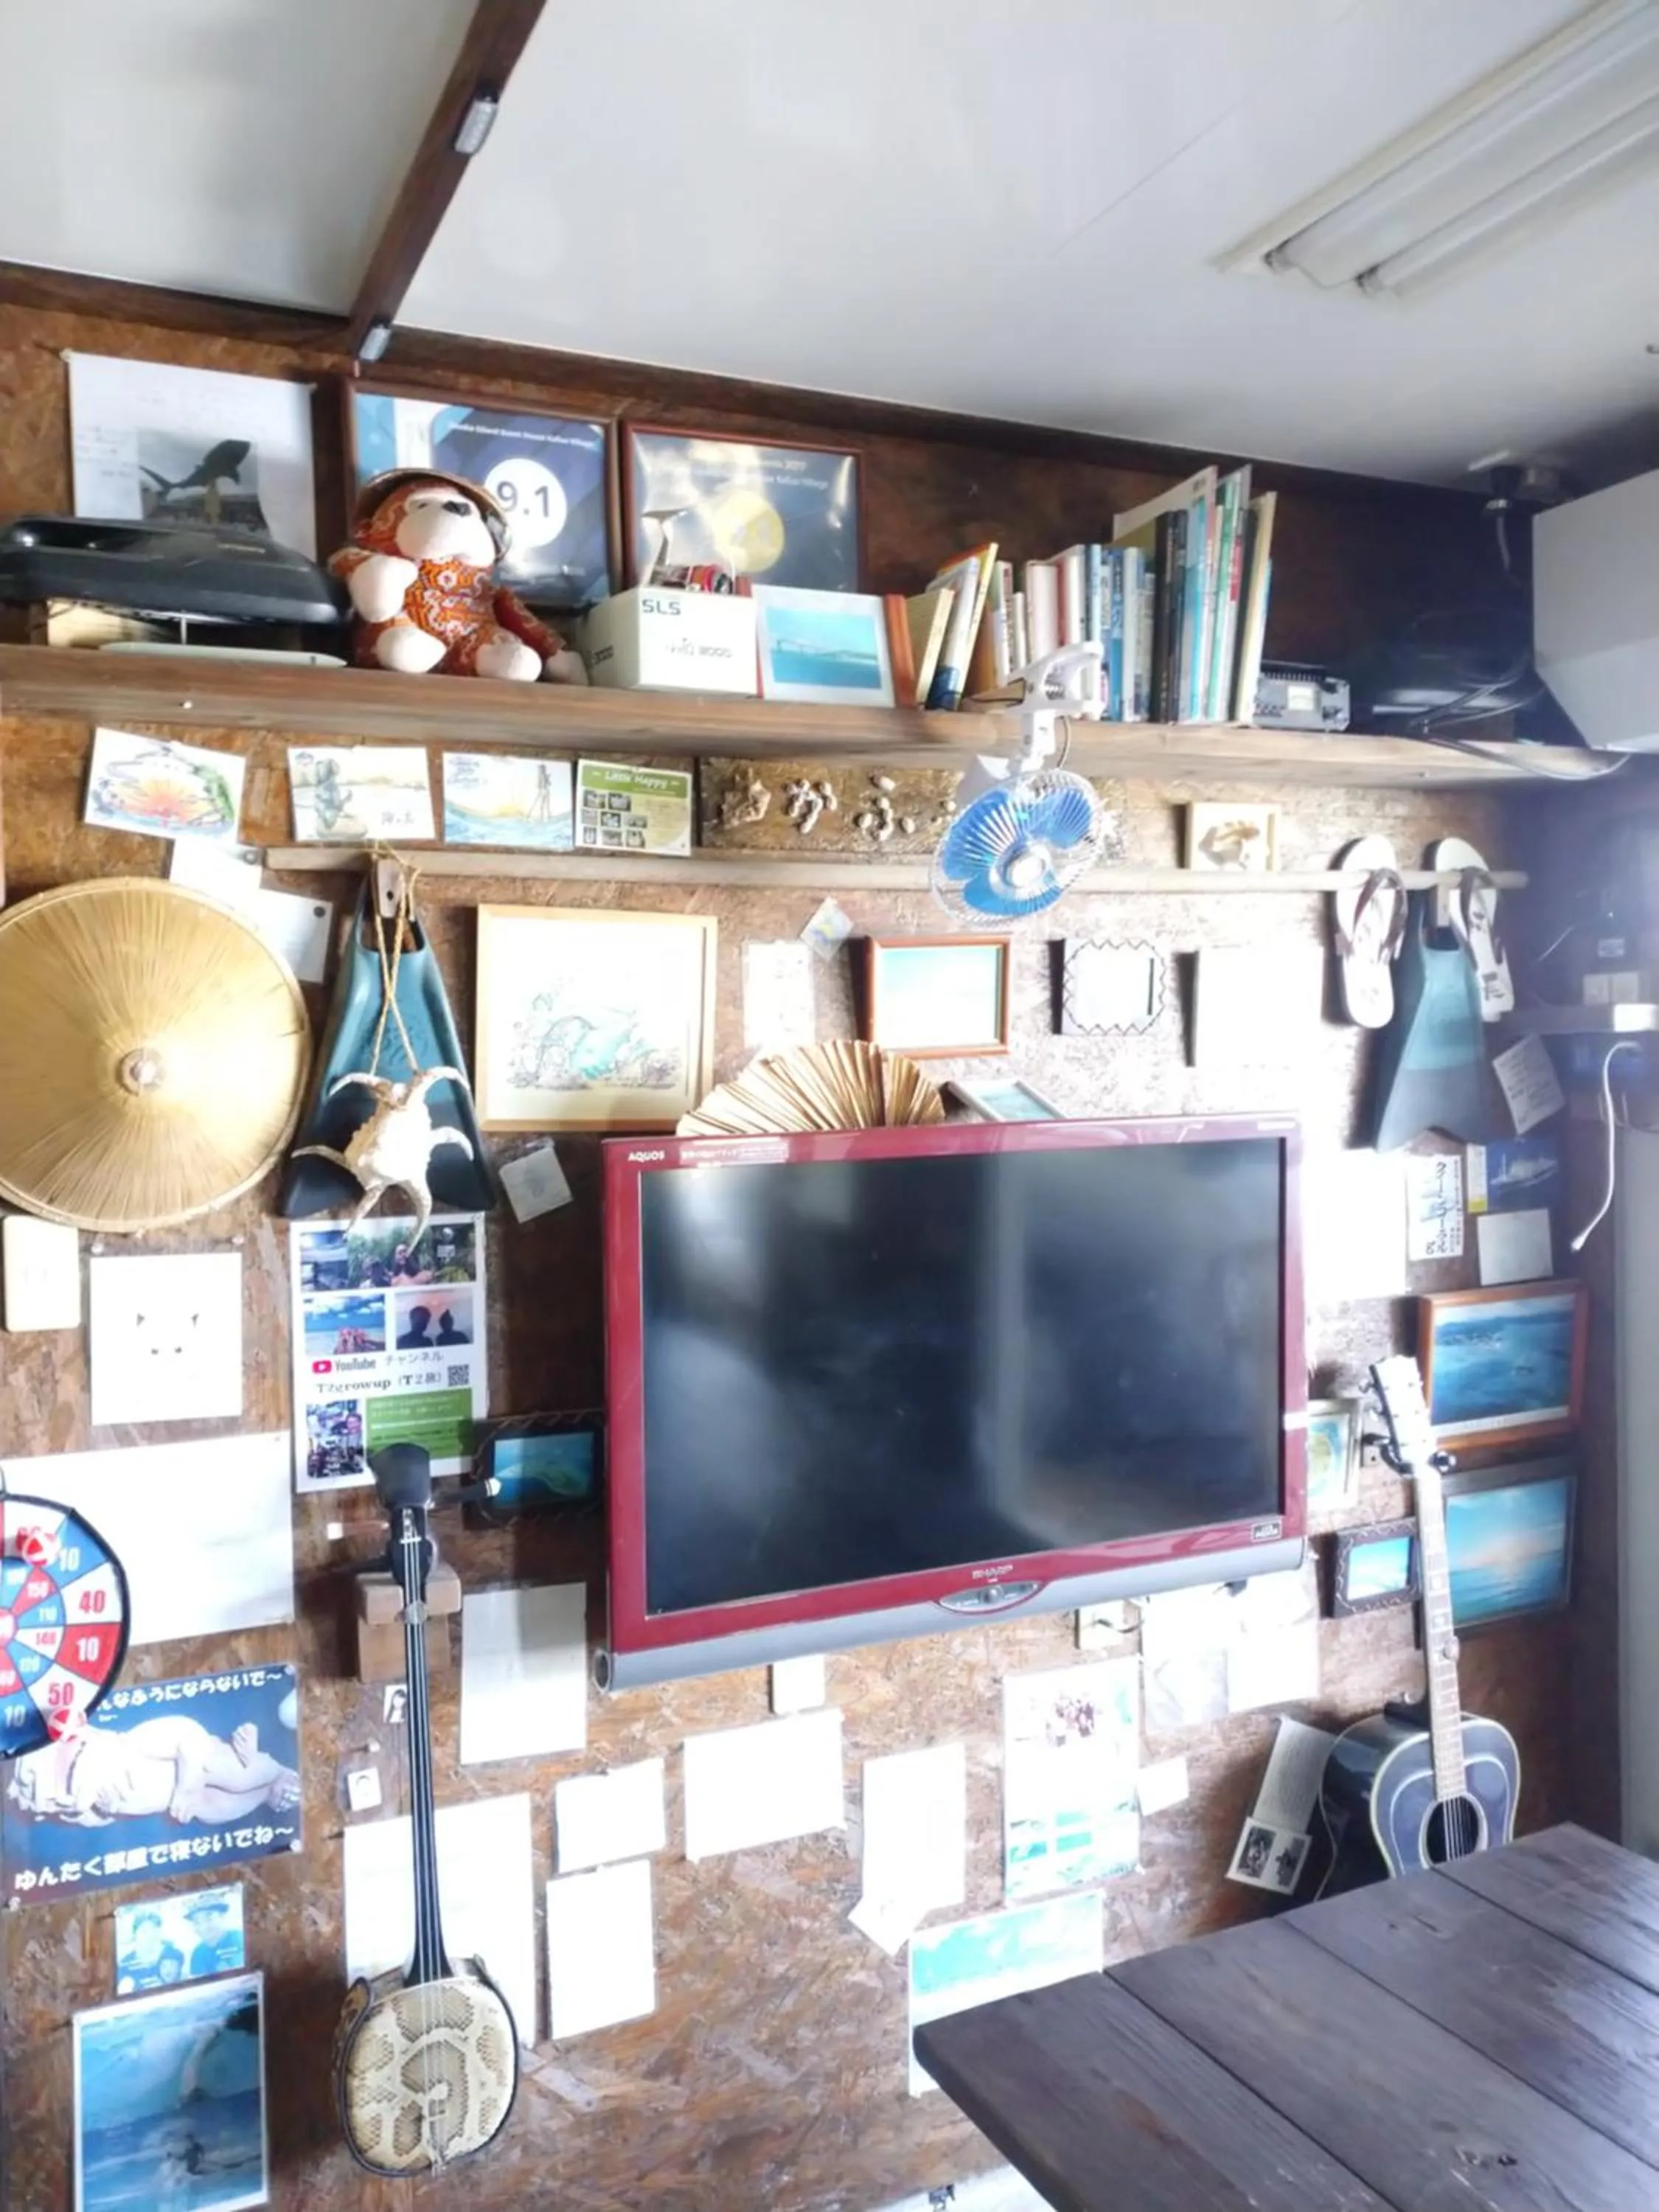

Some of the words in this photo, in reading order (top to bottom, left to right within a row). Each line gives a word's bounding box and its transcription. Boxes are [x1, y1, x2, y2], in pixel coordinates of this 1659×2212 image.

[497, 481, 549, 518] 9.1
[641, 599, 681, 615] SLS
[628, 1150, 665, 1163] AQUOS
[335, 1357, 377, 1372] YouTube
[384, 1351, 443, 1367] チャンネル
[59, 1546, 80, 1573] 10
[79, 1590, 106, 1615] 40
[77, 1635, 100, 1663] 10
[48, 1681, 74, 1706] 50
[4, 1704, 27, 1728] 10
